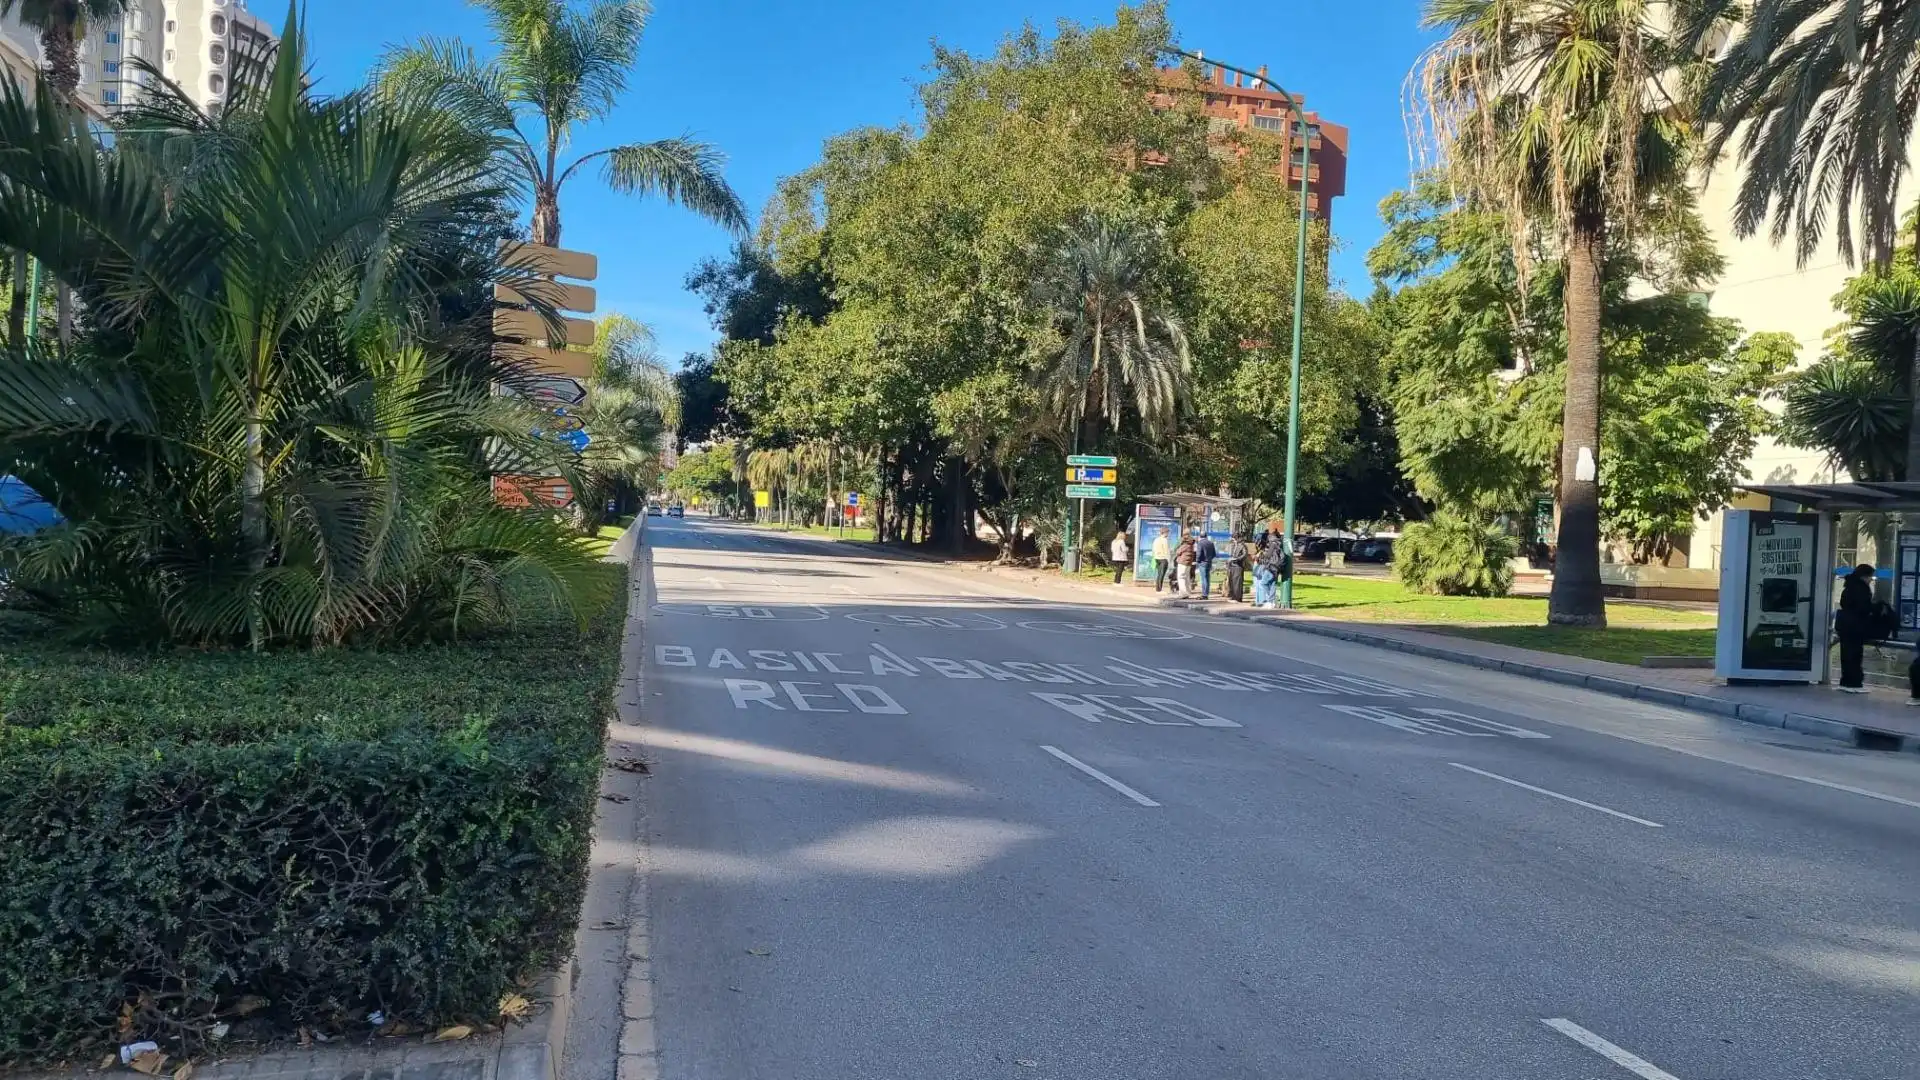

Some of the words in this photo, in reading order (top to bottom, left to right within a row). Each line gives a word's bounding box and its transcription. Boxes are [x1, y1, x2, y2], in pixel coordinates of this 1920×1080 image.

[1766, 538, 1801, 550] MOVILIDAD
[1761, 551, 1800, 563] SOSTENIBLE
[1777, 563, 1802, 575] CAMINO
[706, 605, 776, 619] 50
[888, 614, 964, 628] 50
[724, 678, 909, 715] RED
[1030, 692, 1244, 728] RED
[1320, 704, 1552, 739] RED
